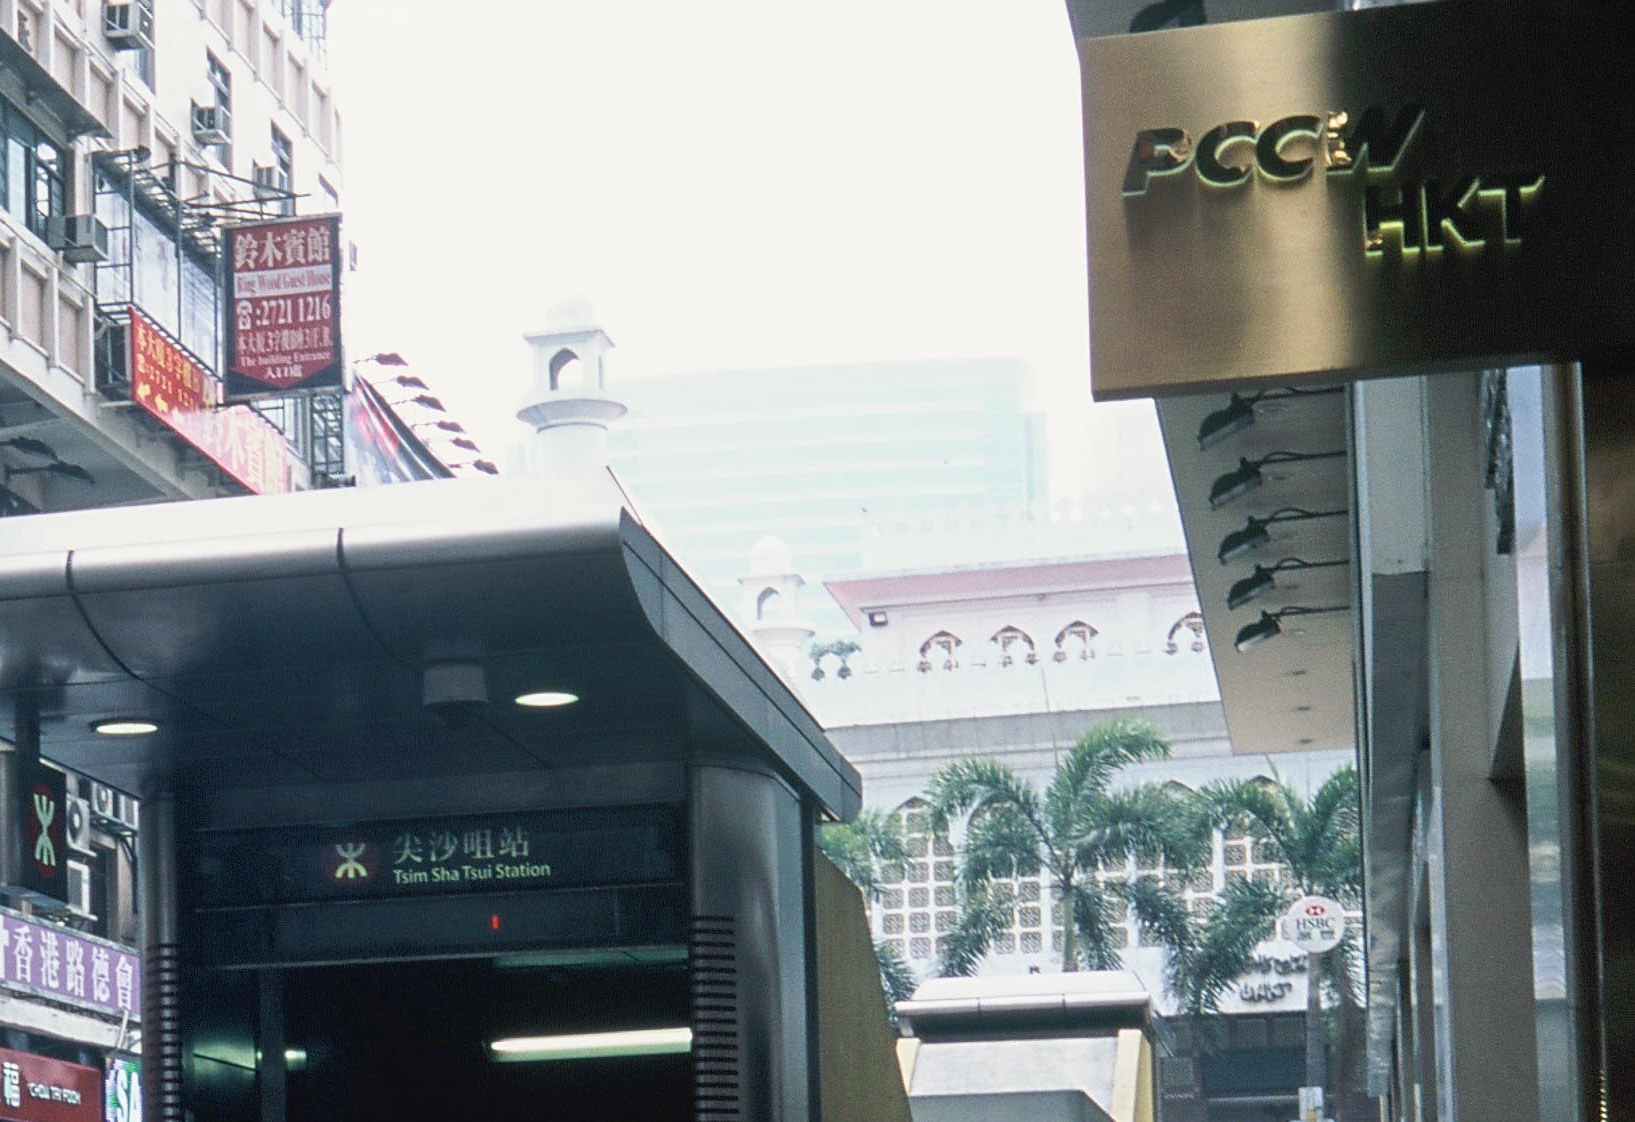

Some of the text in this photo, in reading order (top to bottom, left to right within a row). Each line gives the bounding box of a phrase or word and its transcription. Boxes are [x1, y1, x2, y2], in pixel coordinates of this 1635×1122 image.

[1121, 107, 1426, 197] PCCW
[1362, 175, 1546, 258] HKT
[234, 226, 331, 270] 鈴木賓館
[298, 294, 332, 322] 1216
[241, 350, 331, 367] The building Entrance
[392, 827, 530, 866] 尖沙咀站
[392, 861, 552, 885] Tsim Sha Tsui Station
[1295, 917, 1335, 930] HSBC
[13, 924, 134, 1011] 香港路德會
[27, 1081, 50, 1099] CHOW
[62, 1088, 82, 1106] FOOK
